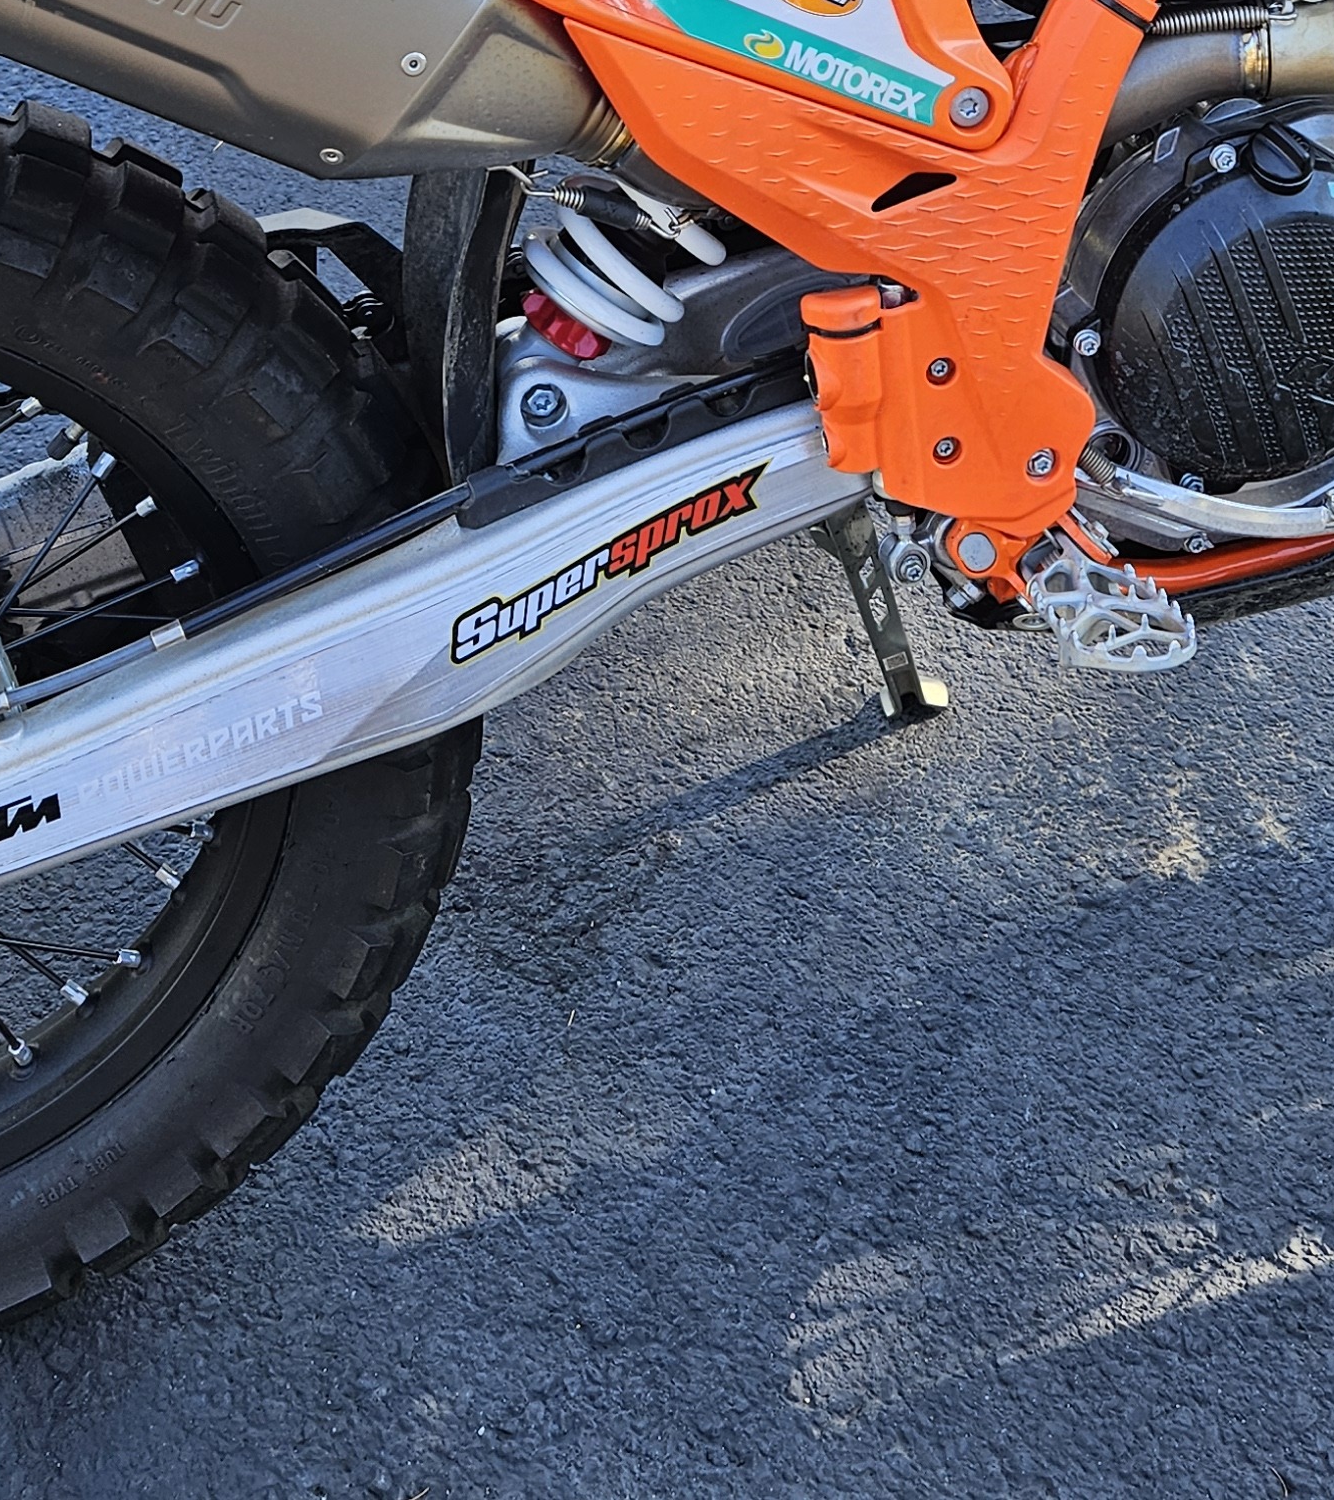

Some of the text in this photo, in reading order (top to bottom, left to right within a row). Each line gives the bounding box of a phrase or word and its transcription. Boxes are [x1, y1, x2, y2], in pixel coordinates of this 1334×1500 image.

[783, 40, 927, 120] MOTOREX
[454, 470, 760, 661] Supersprox
[34, 1140, 128, 1209] TUBE TYPE
